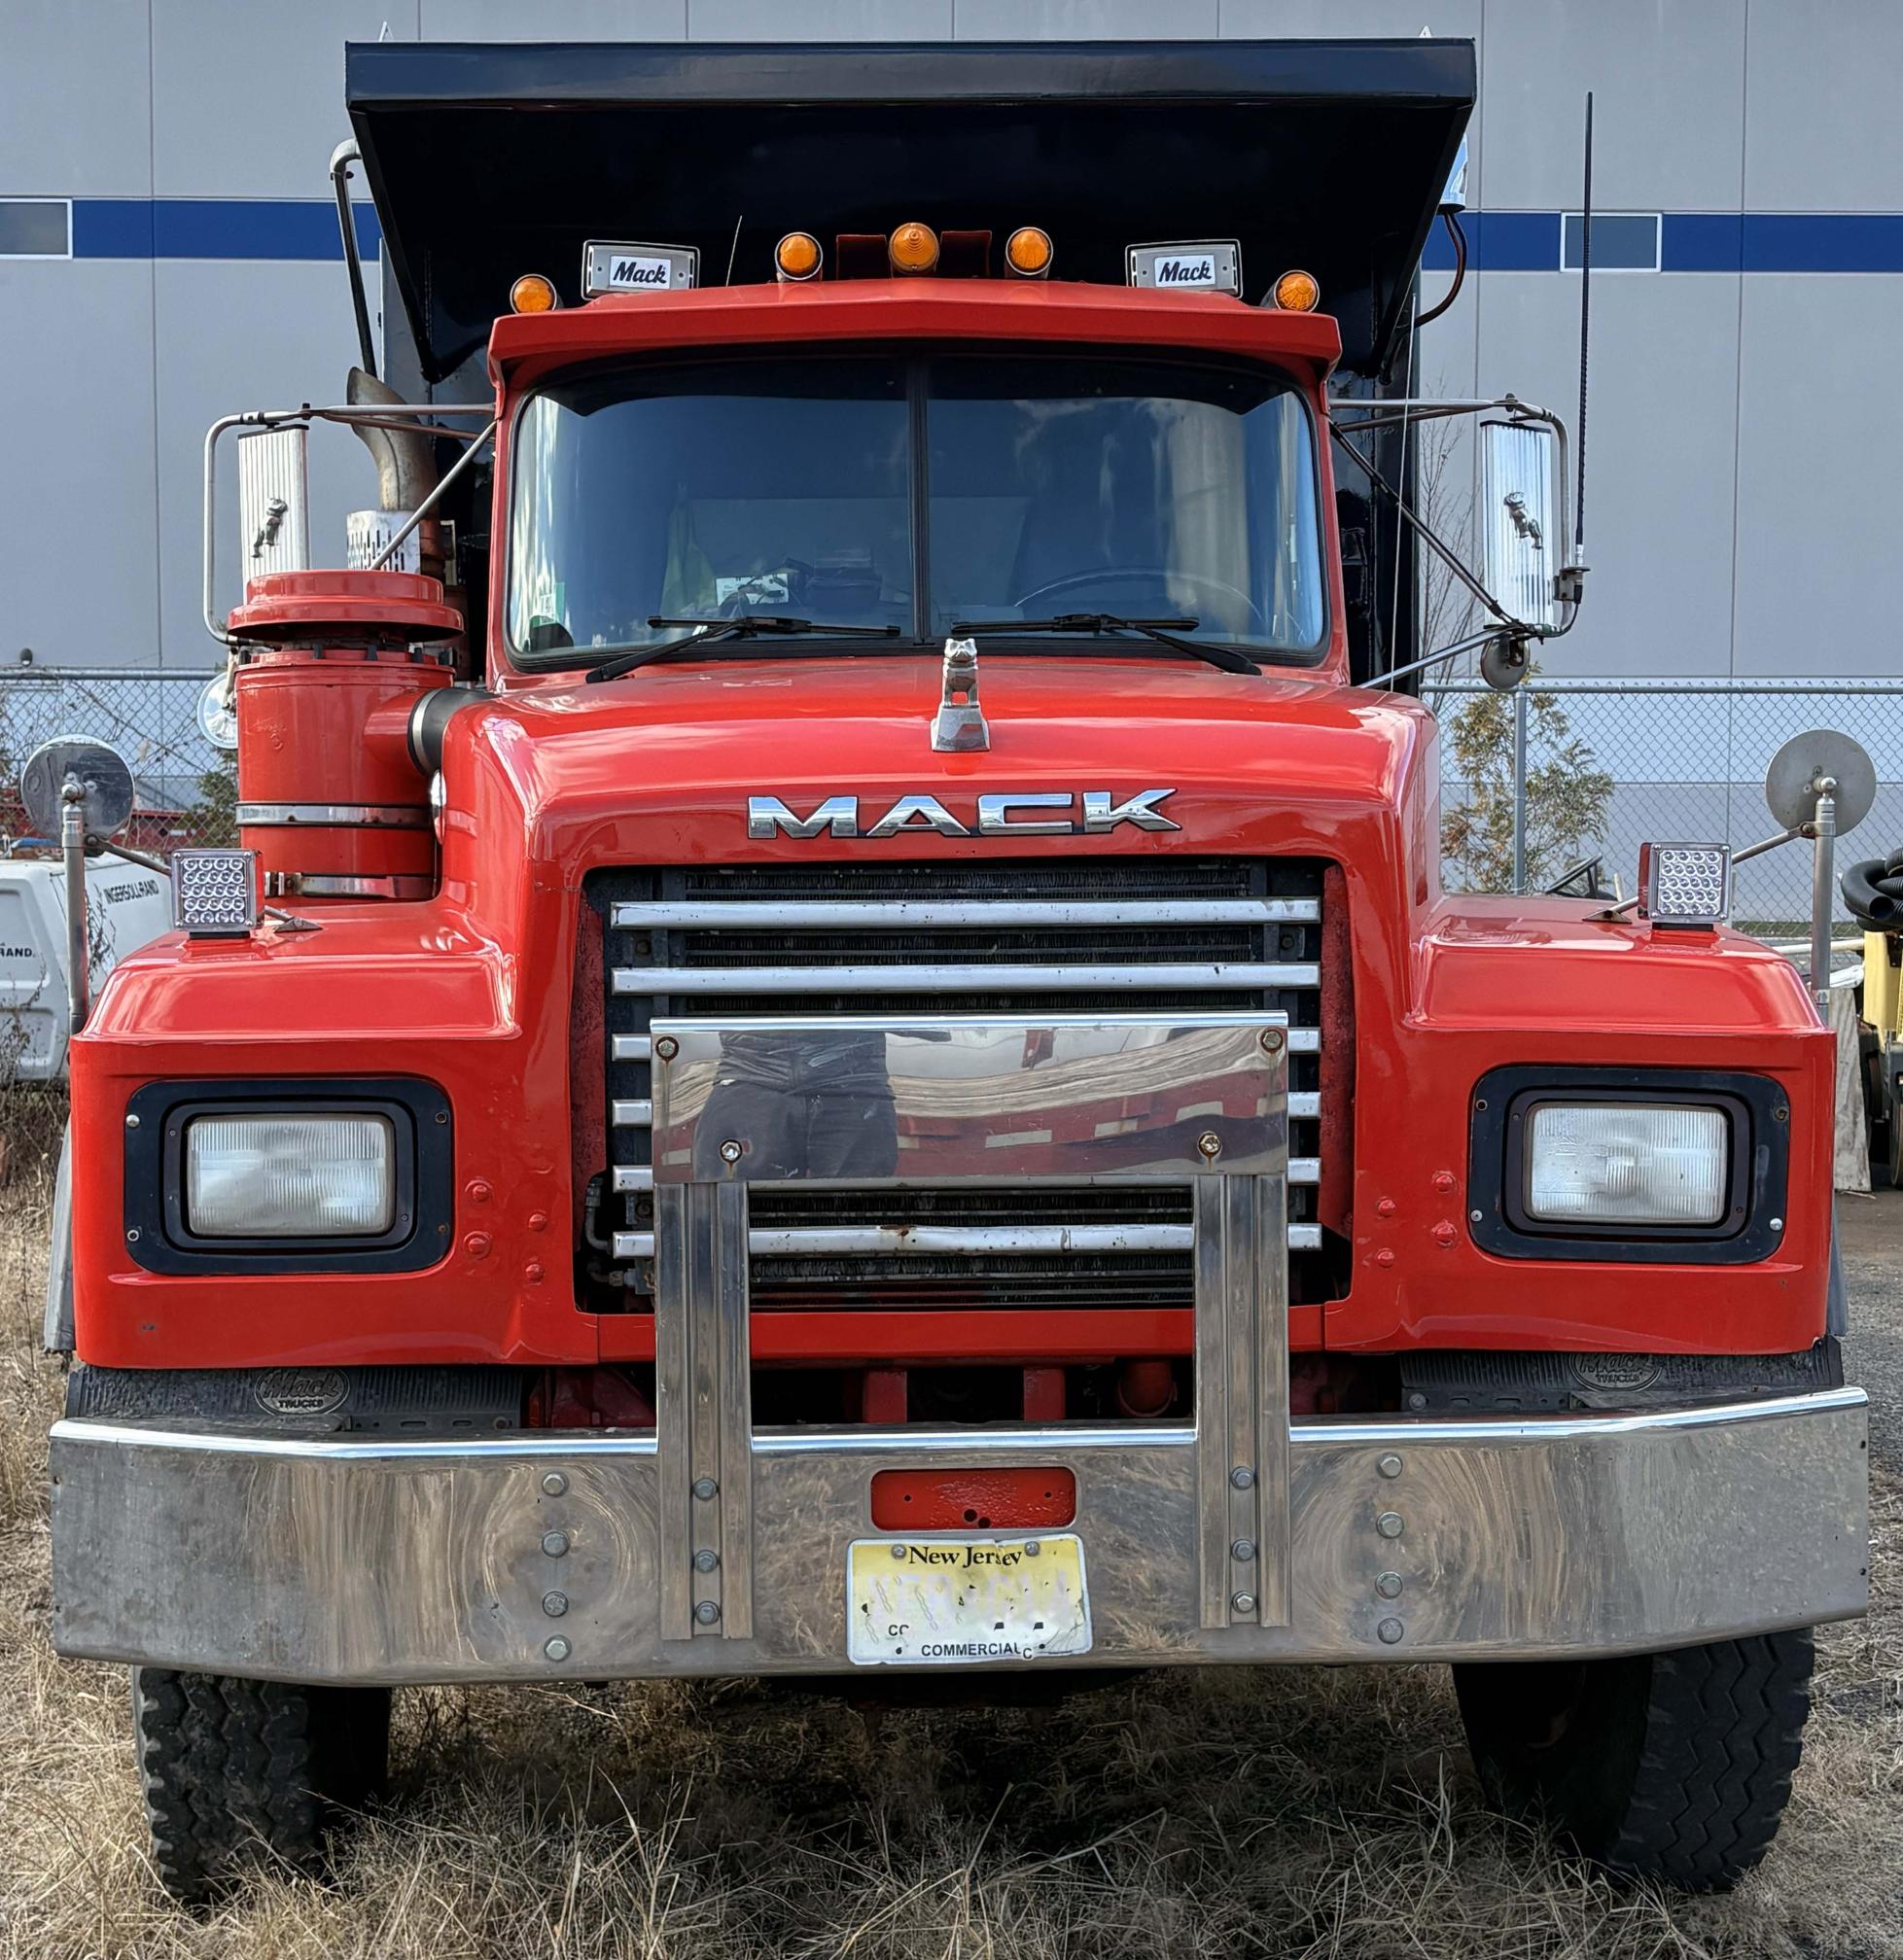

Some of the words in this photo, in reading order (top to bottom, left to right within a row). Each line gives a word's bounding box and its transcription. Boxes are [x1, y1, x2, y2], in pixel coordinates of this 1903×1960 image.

[613, 261, 667, 284] Mack
[1158, 261, 1213, 283] Mack
[748, 788, 1182, 839] MACK
[264, 1369, 339, 1398] Mack
[278, 1399, 324, 1409] TRUCKS
[908, 1546, 960, 1564] New
[921, 1642, 1020, 1657] COMMERCIAL
